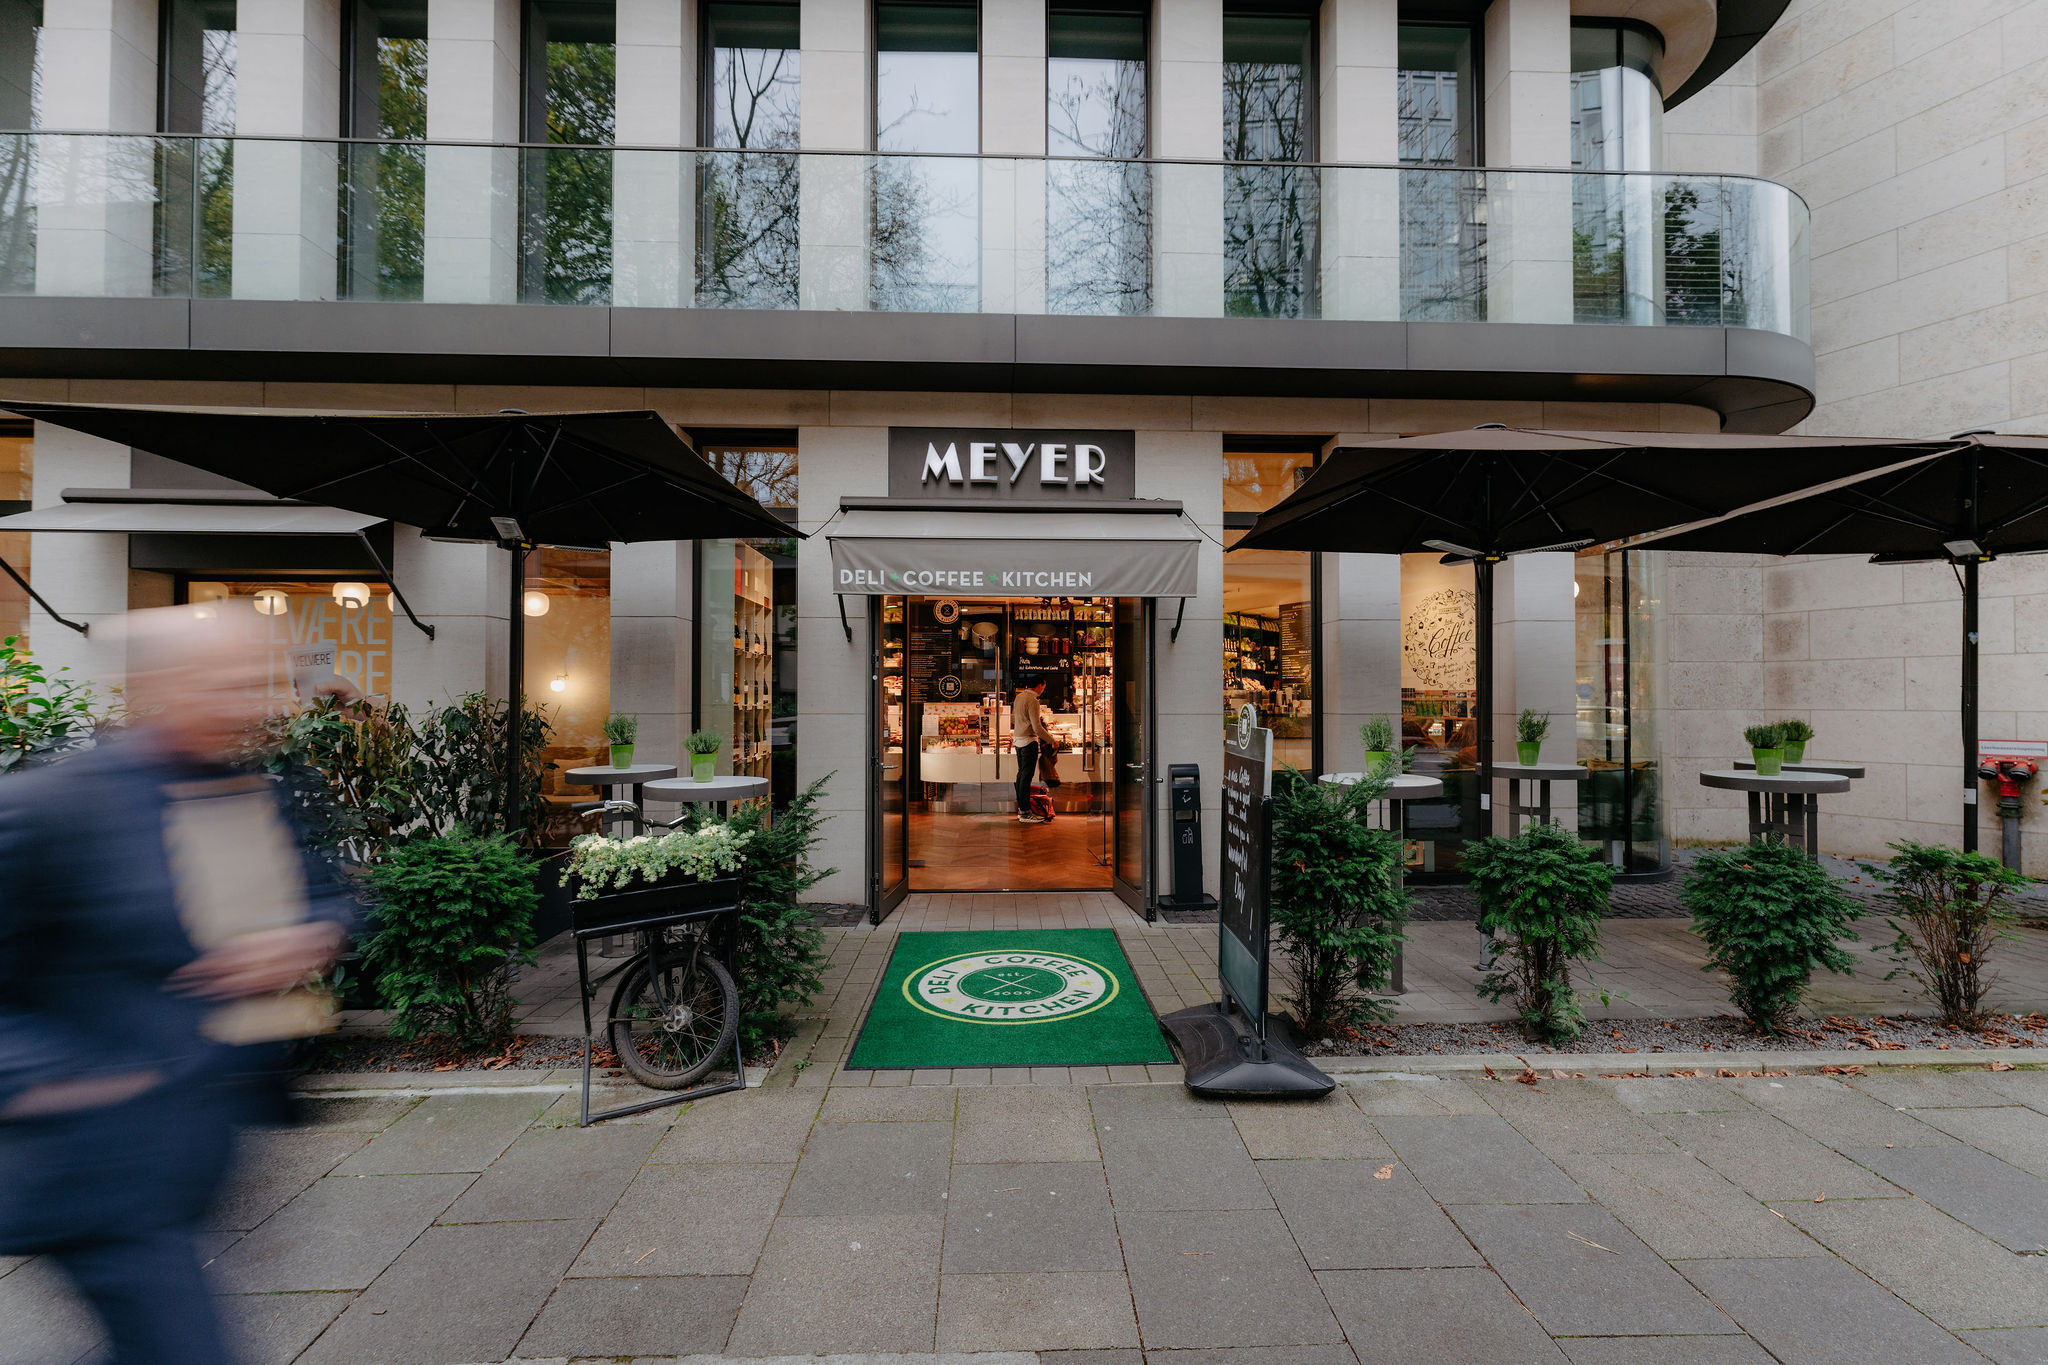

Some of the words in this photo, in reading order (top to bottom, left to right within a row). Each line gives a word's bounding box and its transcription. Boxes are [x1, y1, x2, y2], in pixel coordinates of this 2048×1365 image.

[921, 441, 1106, 485] MEYER
[840, 569, 885, 585] DELI
[903, 570, 984, 587] COFFEE
[1002, 571, 1092, 587] KITCHEN
[1429, 621, 1472, 658] Coffee
[984, 955, 1088, 978] COFFEE
[927, 969, 959, 995] DELI
[960, 989, 1094, 1016] KITCHEN
